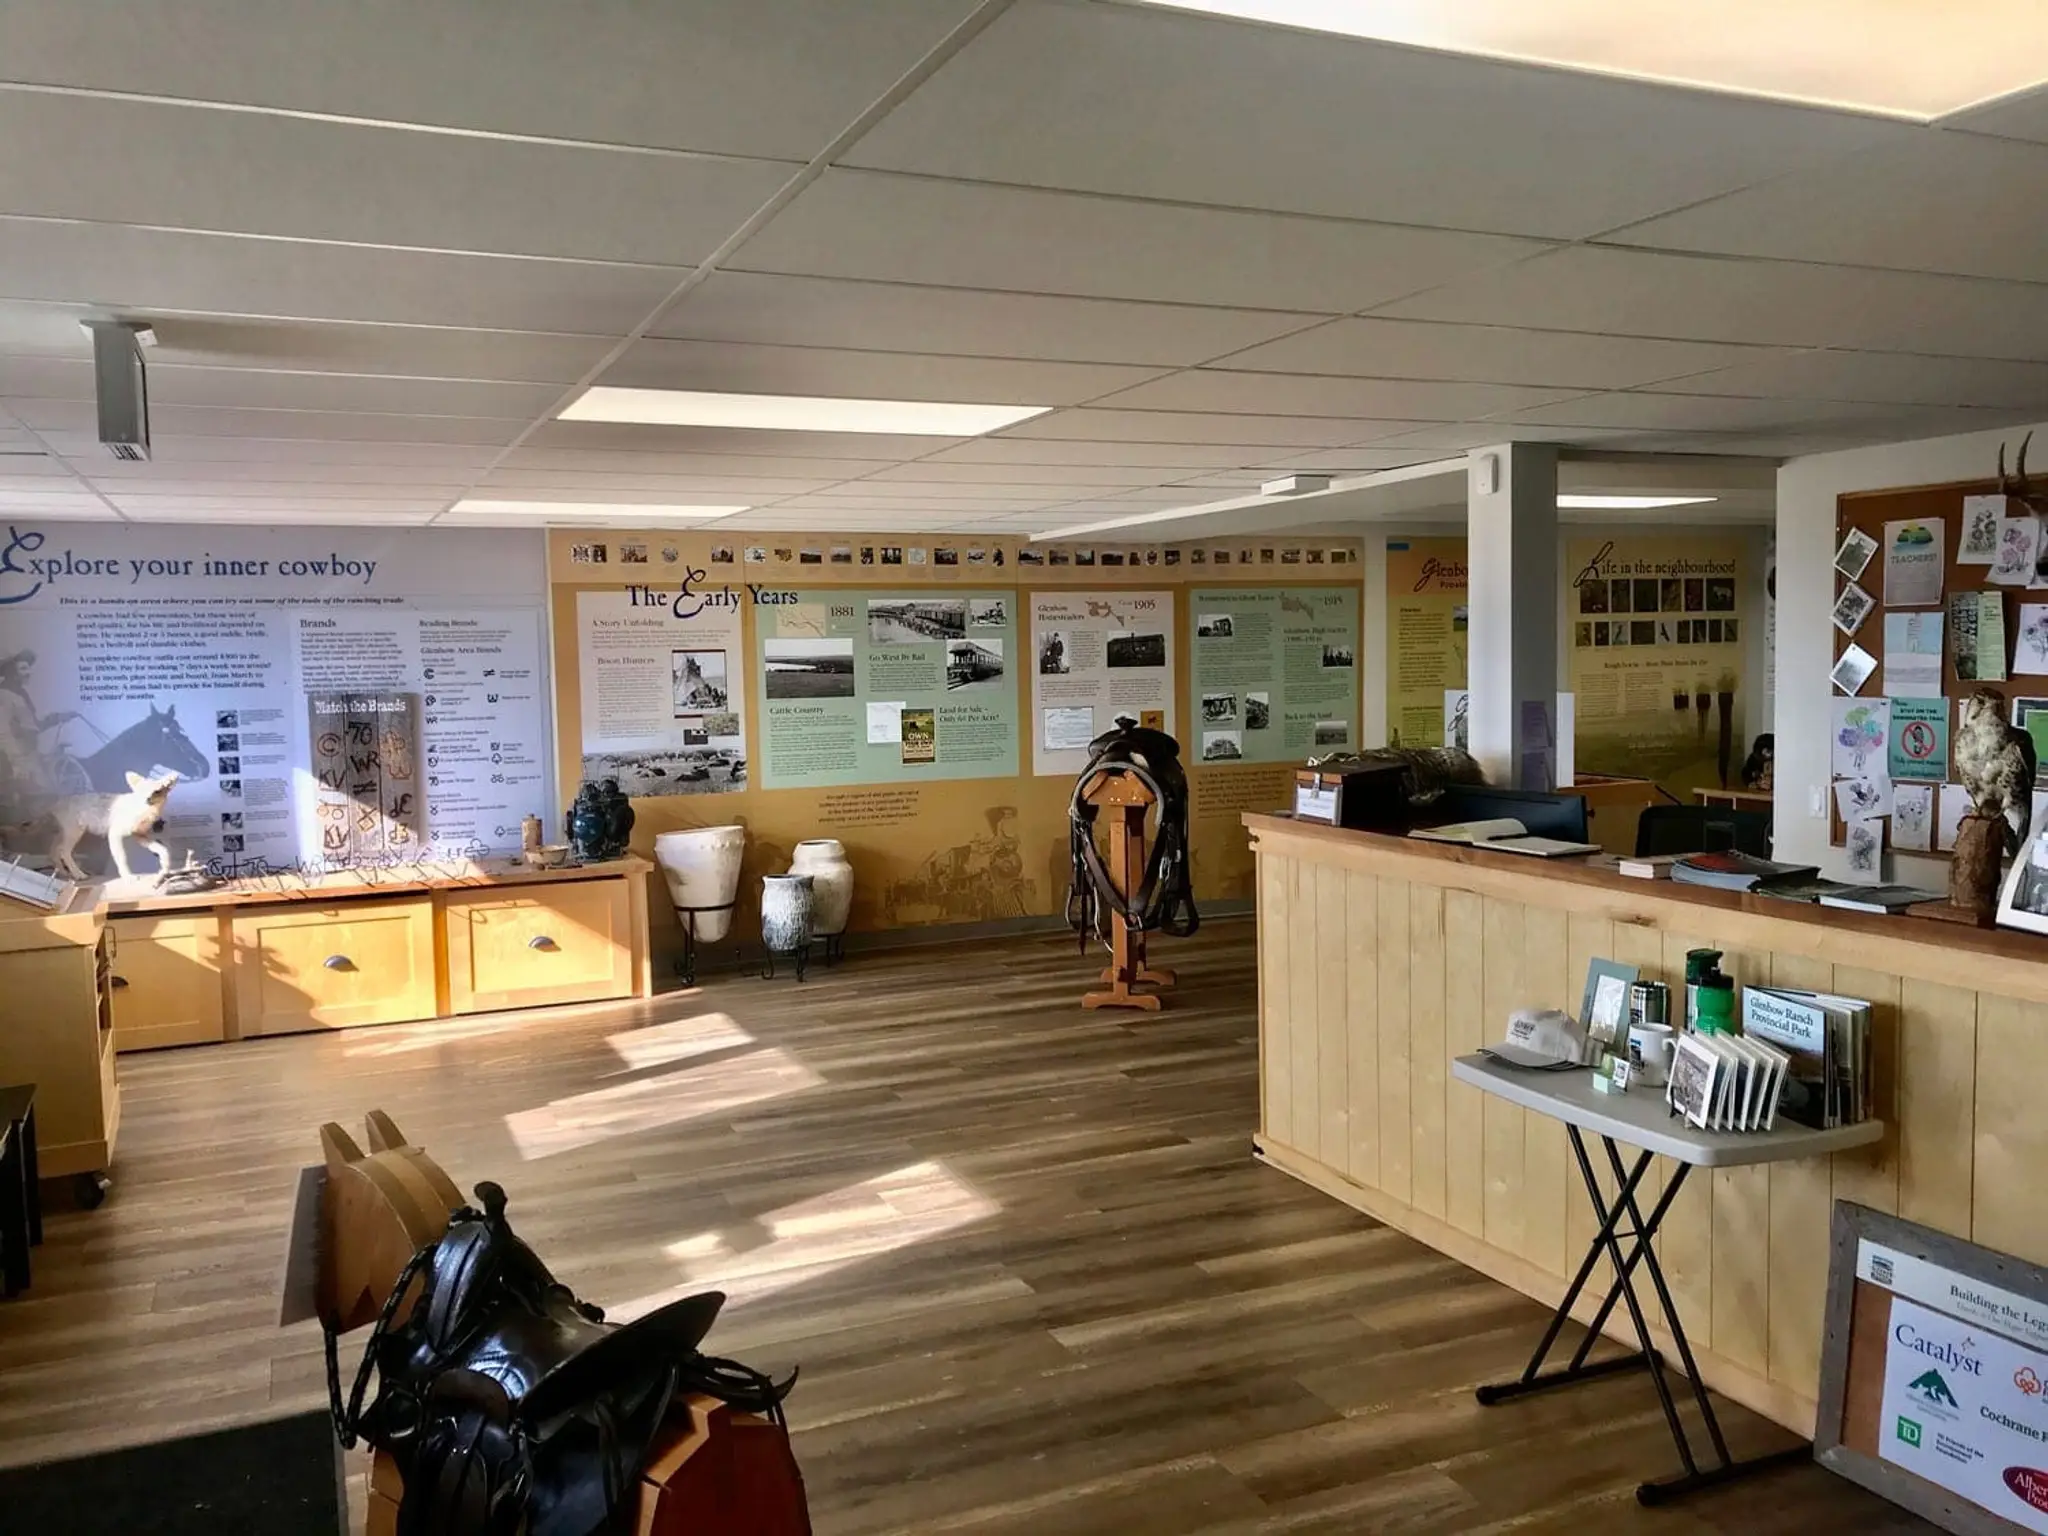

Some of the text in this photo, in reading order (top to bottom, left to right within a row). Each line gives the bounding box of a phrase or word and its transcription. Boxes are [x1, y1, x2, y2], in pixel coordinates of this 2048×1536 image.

[0, 526, 376, 604] Explore your inner cowboy
[1573, 541, 1736, 588] Life in the neighbourhood
[625, 565, 798, 619] The Early Years
[1134, 599, 1156, 610] 1905
[300, 618, 336, 629] Brands
[831, 606, 854, 617] 1881
[368, 699, 406, 713] Brands
[1751, 997, 1813, 1026] Glenbow Ranch
[1752, 1009, 1789, 1031] Provincial
[1792, 1023, 1811, 1039] Park
[1950, 1285, 1999, 1315] Building
[2002, 1304, 2020, 1320] the
[2024, 1311, 2048, 1333] Leg
[1896, 1324, 1984, 1377] Catalyst
[1900, 1420, 1918, 1441] TD
[1980, 1405, 2040, 1440] Cochrane
